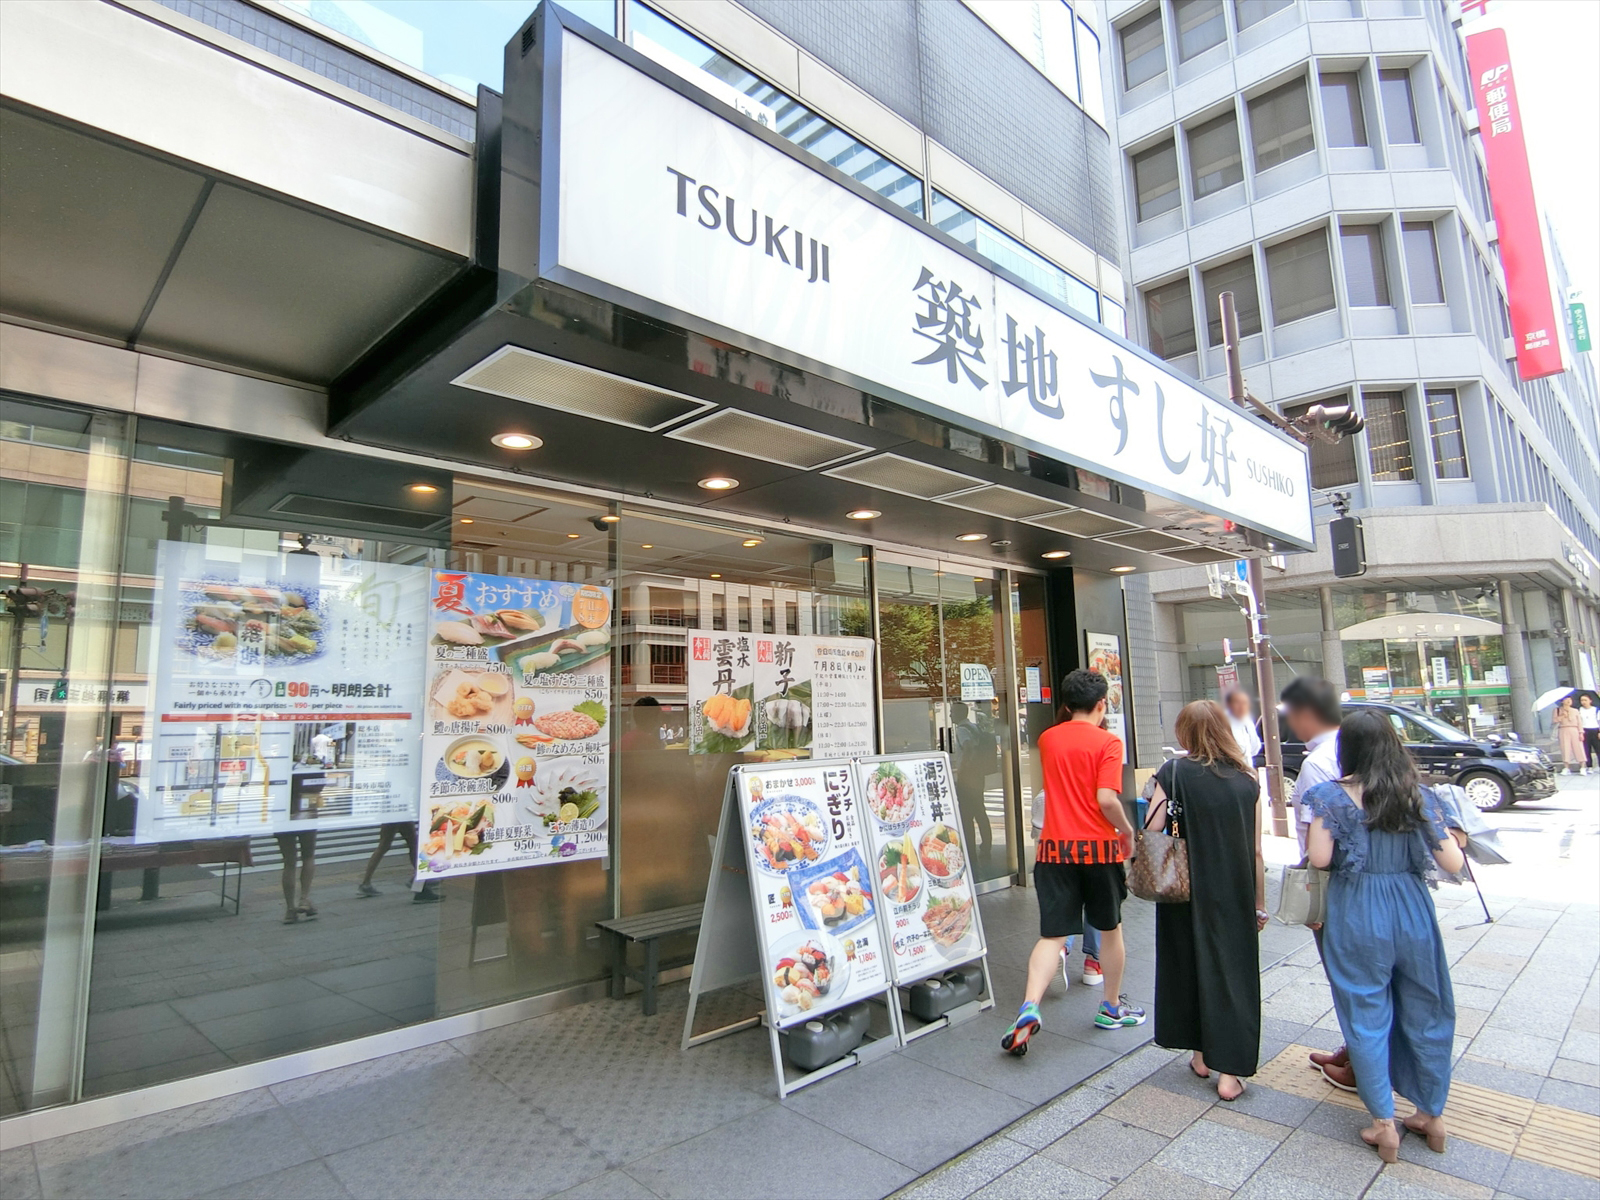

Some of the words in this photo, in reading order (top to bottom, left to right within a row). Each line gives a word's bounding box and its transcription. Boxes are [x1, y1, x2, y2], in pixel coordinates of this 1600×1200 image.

[1485, 85, 1512, 138] 郵便局
[666, 165, 830, 284] TSUKIJI
[911, 265, 1065, 421] 築地
[1089, 354, 1238, 498] すし好
[1245, 457, 1296, 498] SUSHIKO
[432, 574, 475, 615] 夏
[475, 582, 560, 609] おすすめ
[434, 646, 489, 662] 夏の三種盛
[737, 636, 751, 669] 塩水
[485, 661, 513, 674] 750円
[713, 638, 736, 696] 雲丹
[774, 641, 796, 695] 新子
[963, 667, 990, 681] OPEN
[523, 672, 605, 688] 夏の塩すだち三種盛
[584, 689, 608, 700] 850円
[173, 701, 197, 710] Fairly
[198, 701, 223, 710] priced
[254, 702, 287, 710] surprises
[312, 702, 323, 710] per
[324, 701, 343, 710] piece
[486, 723, 513, 735] 800円
[582, 755, 605, 765] 780円
[430, 779, 497, 795] 季節の茶碗蒸し
[765, 779, 794, 789] おまかせ
[936, 761, 949, 799] ランチ
[491, 793, 518, 805] 800円
[838, 769, 853, 812] ランチ
[923, 761, 944, 822] 海鮮丼
[823, 771, 845, 841] にぎり
[485, 824, 533, 842] 海鮮夏野菜
[549, 819, 596, 834] こちの薄造り
[514, 839, 541, 851] 950円
